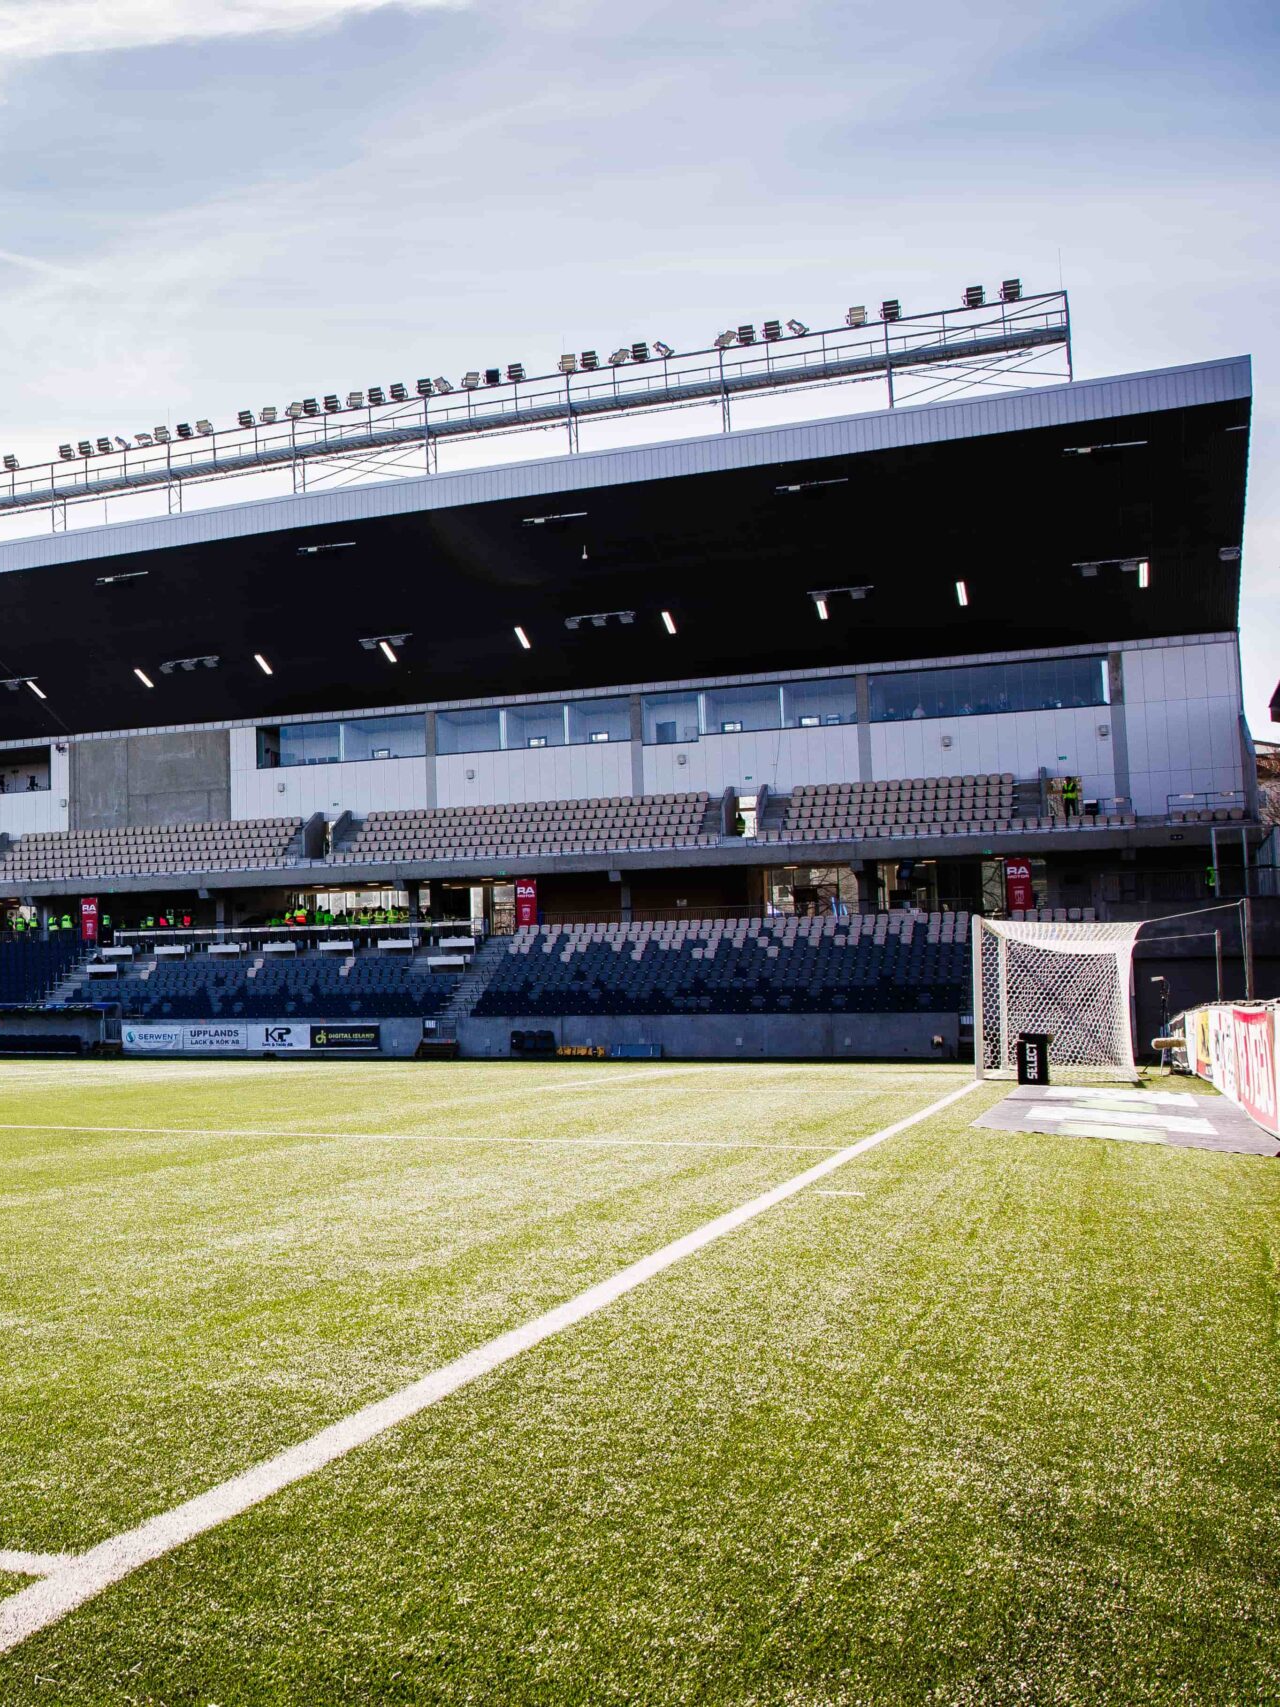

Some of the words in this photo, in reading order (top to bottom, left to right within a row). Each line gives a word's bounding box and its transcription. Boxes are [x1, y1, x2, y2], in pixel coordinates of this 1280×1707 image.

[1006, 866, 1029, 875] RA
[516, 886, 535, 894] RA
[190, 1029, 239, 1037] UPPLANDS
[1026, 1043, 1038, 1079] SELECT
